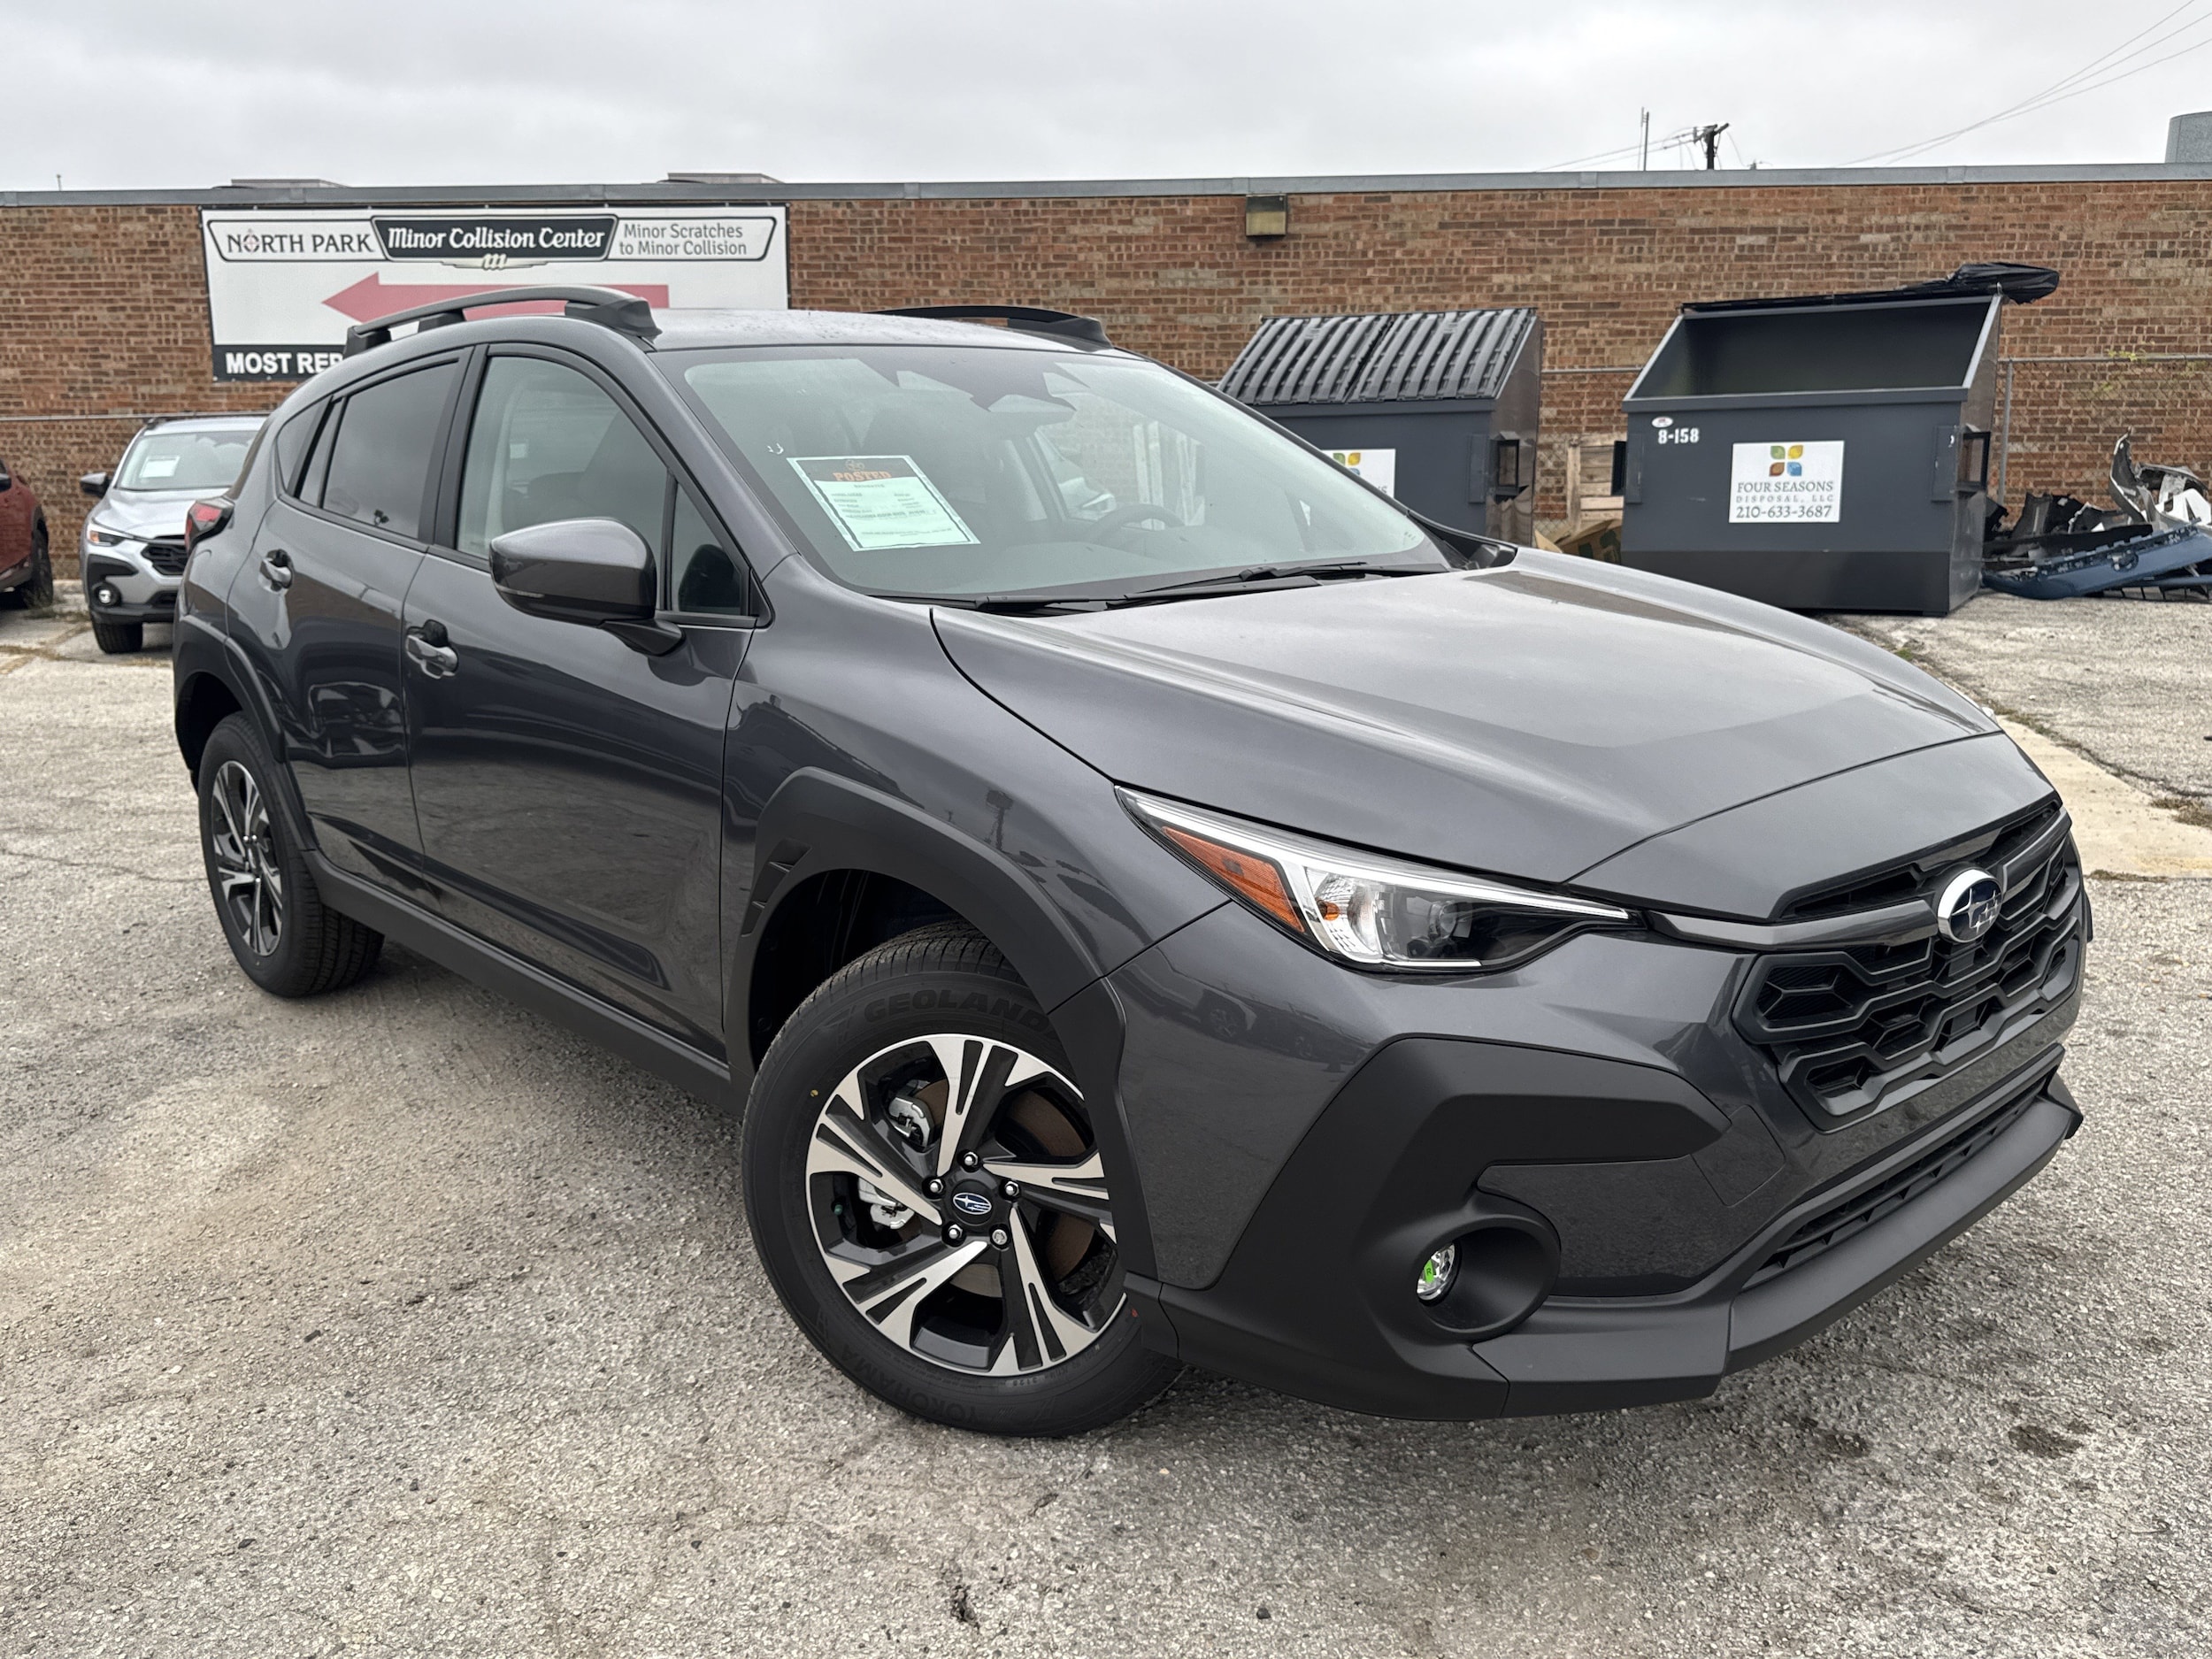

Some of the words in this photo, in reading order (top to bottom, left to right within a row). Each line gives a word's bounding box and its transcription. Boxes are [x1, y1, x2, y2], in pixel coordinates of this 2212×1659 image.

[388, 227, 447, 249] Minor
[449, 227, 536, 249] Collision
[538, 227, 605, 249] Center
[624, 224, 667, 239] Minor
[670, 223, 743, 239] Scratches
[227, 233, 305, 253] NORTH
[311, 234, 374, 253] PARK
[619, 242, 634, 256] to
[638, 242, 680, 256] Minor
[683, 240, 747, 256] Collision
[226, 352, 292, 374] MOST
[1657, 427, 1700, 445] 8-158
[833, 470, 893, 482] POSTED
[1737, 482, 1770, 493] FOUR
[1774, 480, 1834, 493] SEASONS
[1811, 495, 1834, 503] LLC
[1735, 505, 1832, 519] 210-633-3687
[1426, 1267, 1432, 1276] R
[841, 1344, 979, 1424] YOKOHAMA
